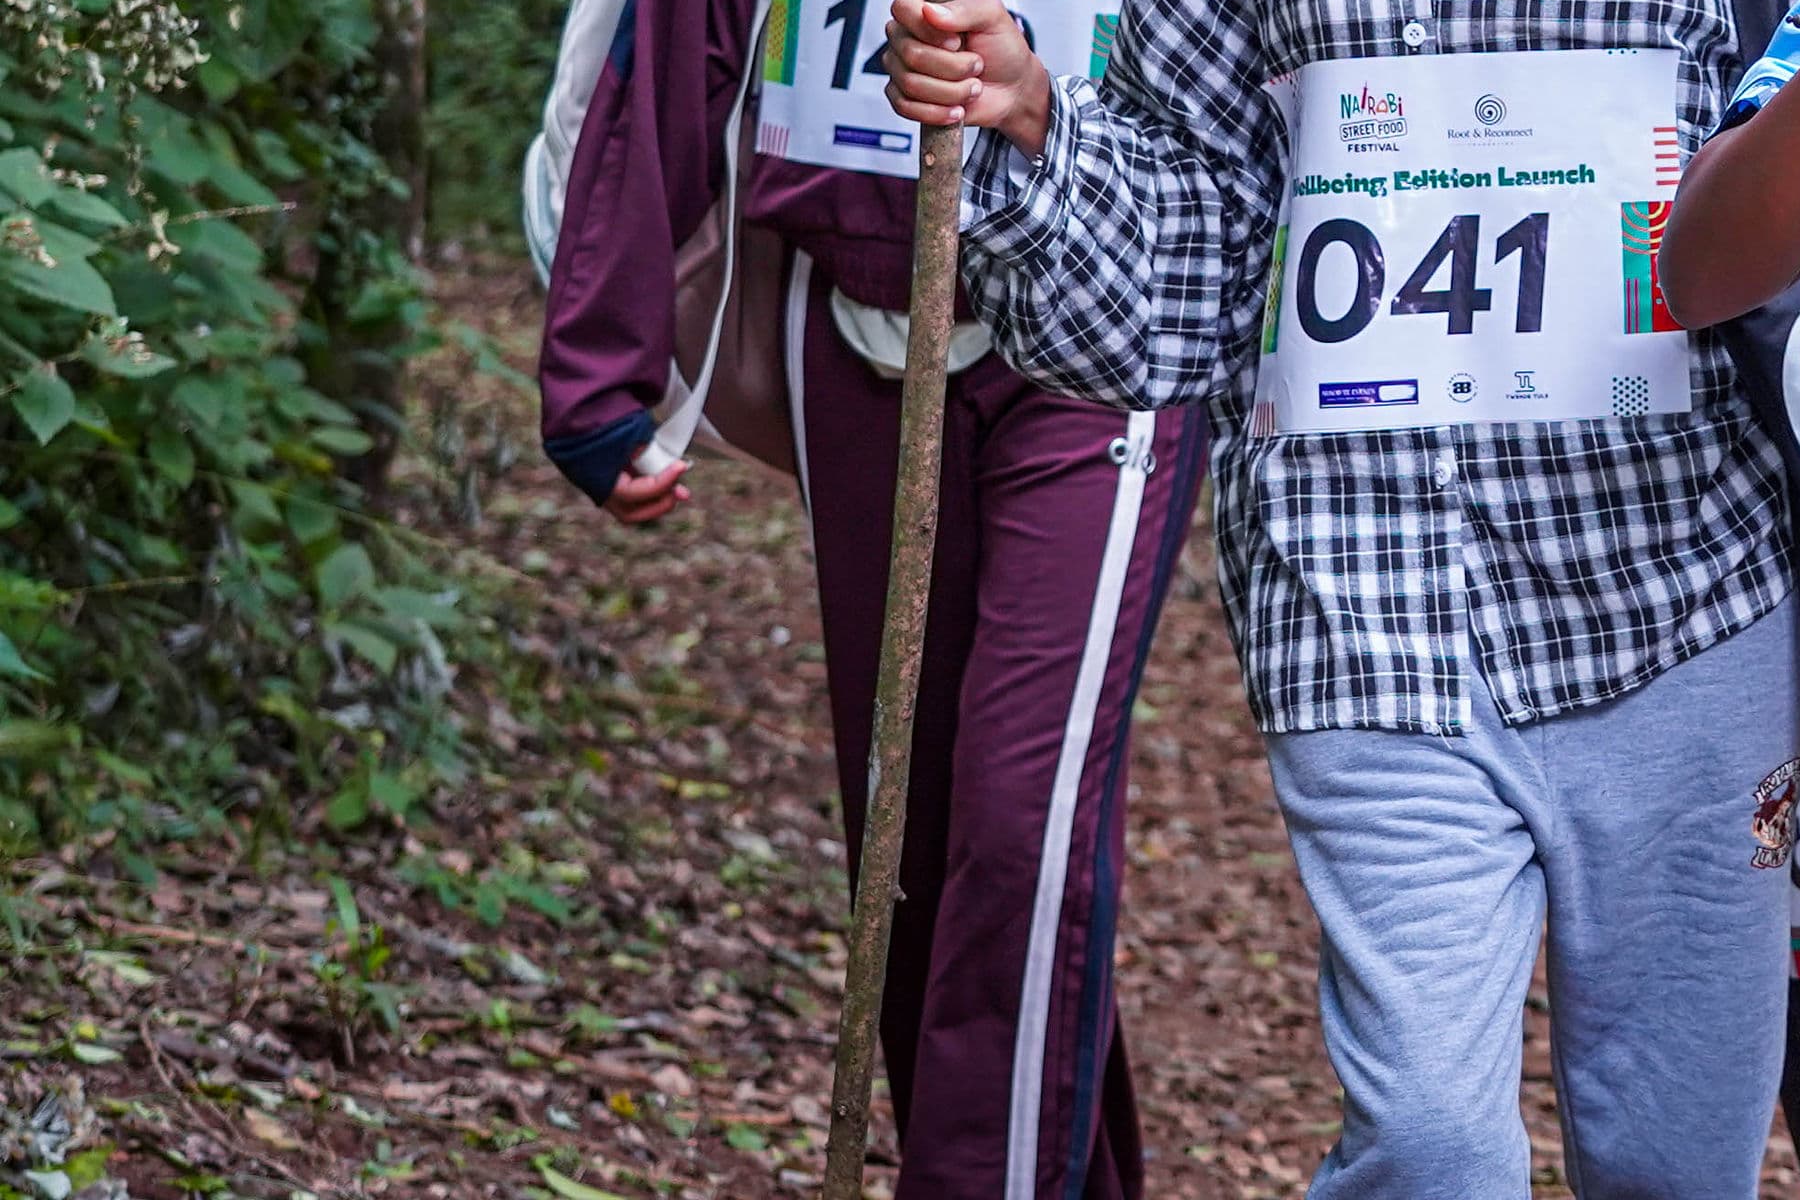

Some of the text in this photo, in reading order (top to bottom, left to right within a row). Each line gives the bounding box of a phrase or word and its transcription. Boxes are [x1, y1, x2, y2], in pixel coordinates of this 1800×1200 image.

[1342, 120, 1404, 139] STREET FOOD
[1447, 127, 1534, 139] Root & Reconnect
[1347, 143, 1400, 153] FESTIVAL
[1394, 168, 1491, 191] Edition
[1498, 164, 1595, 188] Launch
[1296, 212, 1549, 343] 041
